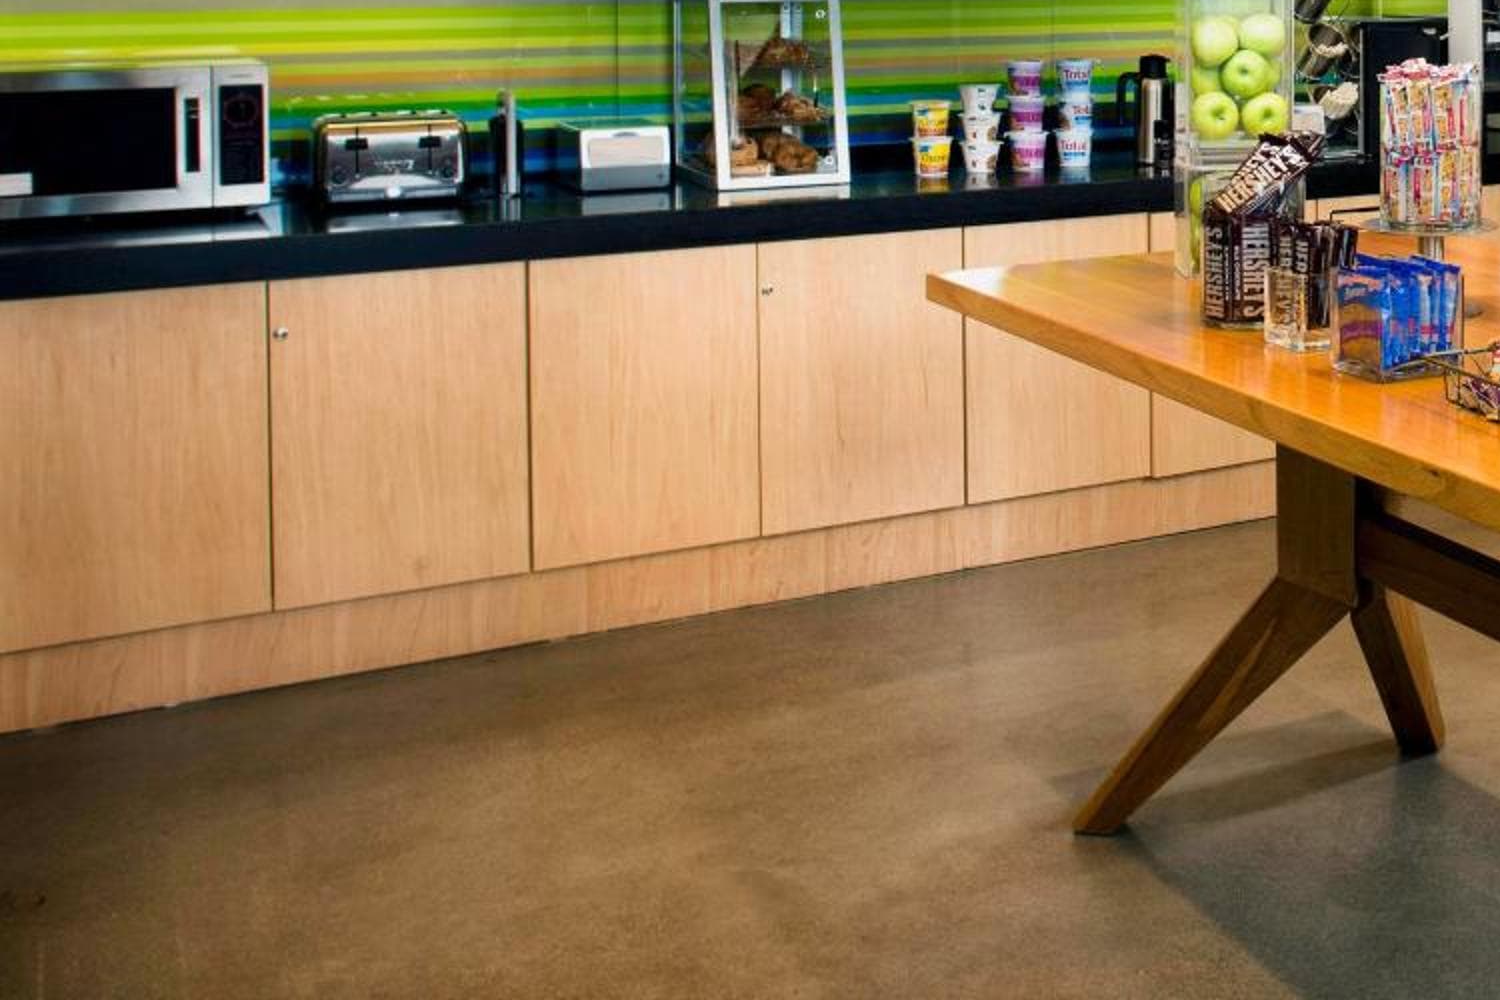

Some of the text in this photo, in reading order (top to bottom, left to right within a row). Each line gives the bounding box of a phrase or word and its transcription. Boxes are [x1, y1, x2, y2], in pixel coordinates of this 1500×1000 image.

[1216, 144, 1303, 214] HERSHEY'S
[1206, 225, 1225, 318] HERSHEY'S
[1242, 222, 1270, 319] HERSHEYS
